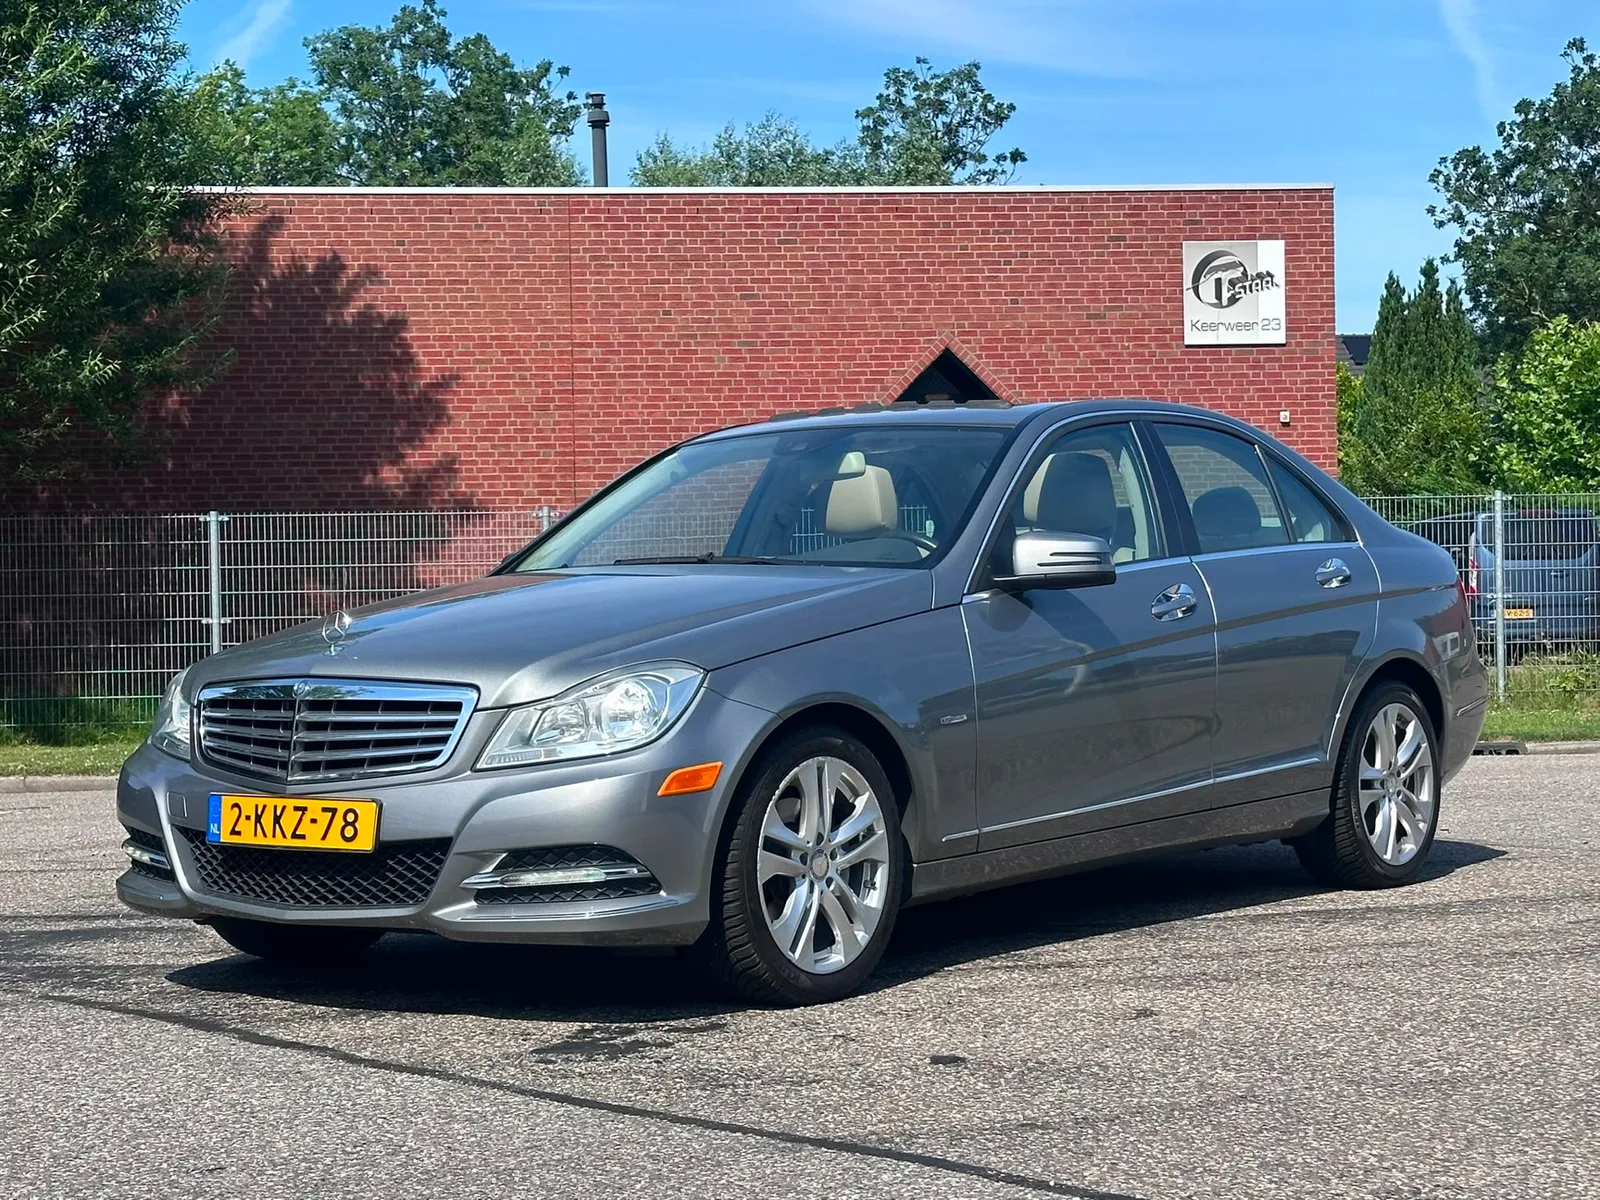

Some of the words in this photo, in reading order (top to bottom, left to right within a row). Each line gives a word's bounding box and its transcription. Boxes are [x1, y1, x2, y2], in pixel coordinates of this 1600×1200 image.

[1190, 319, 1259, 332] Keerweer
[1260, 317, 1282, 331] 23
[210, 823, 220, 834] NL
[229, 802, 359, 843] 2-KKZ-78
